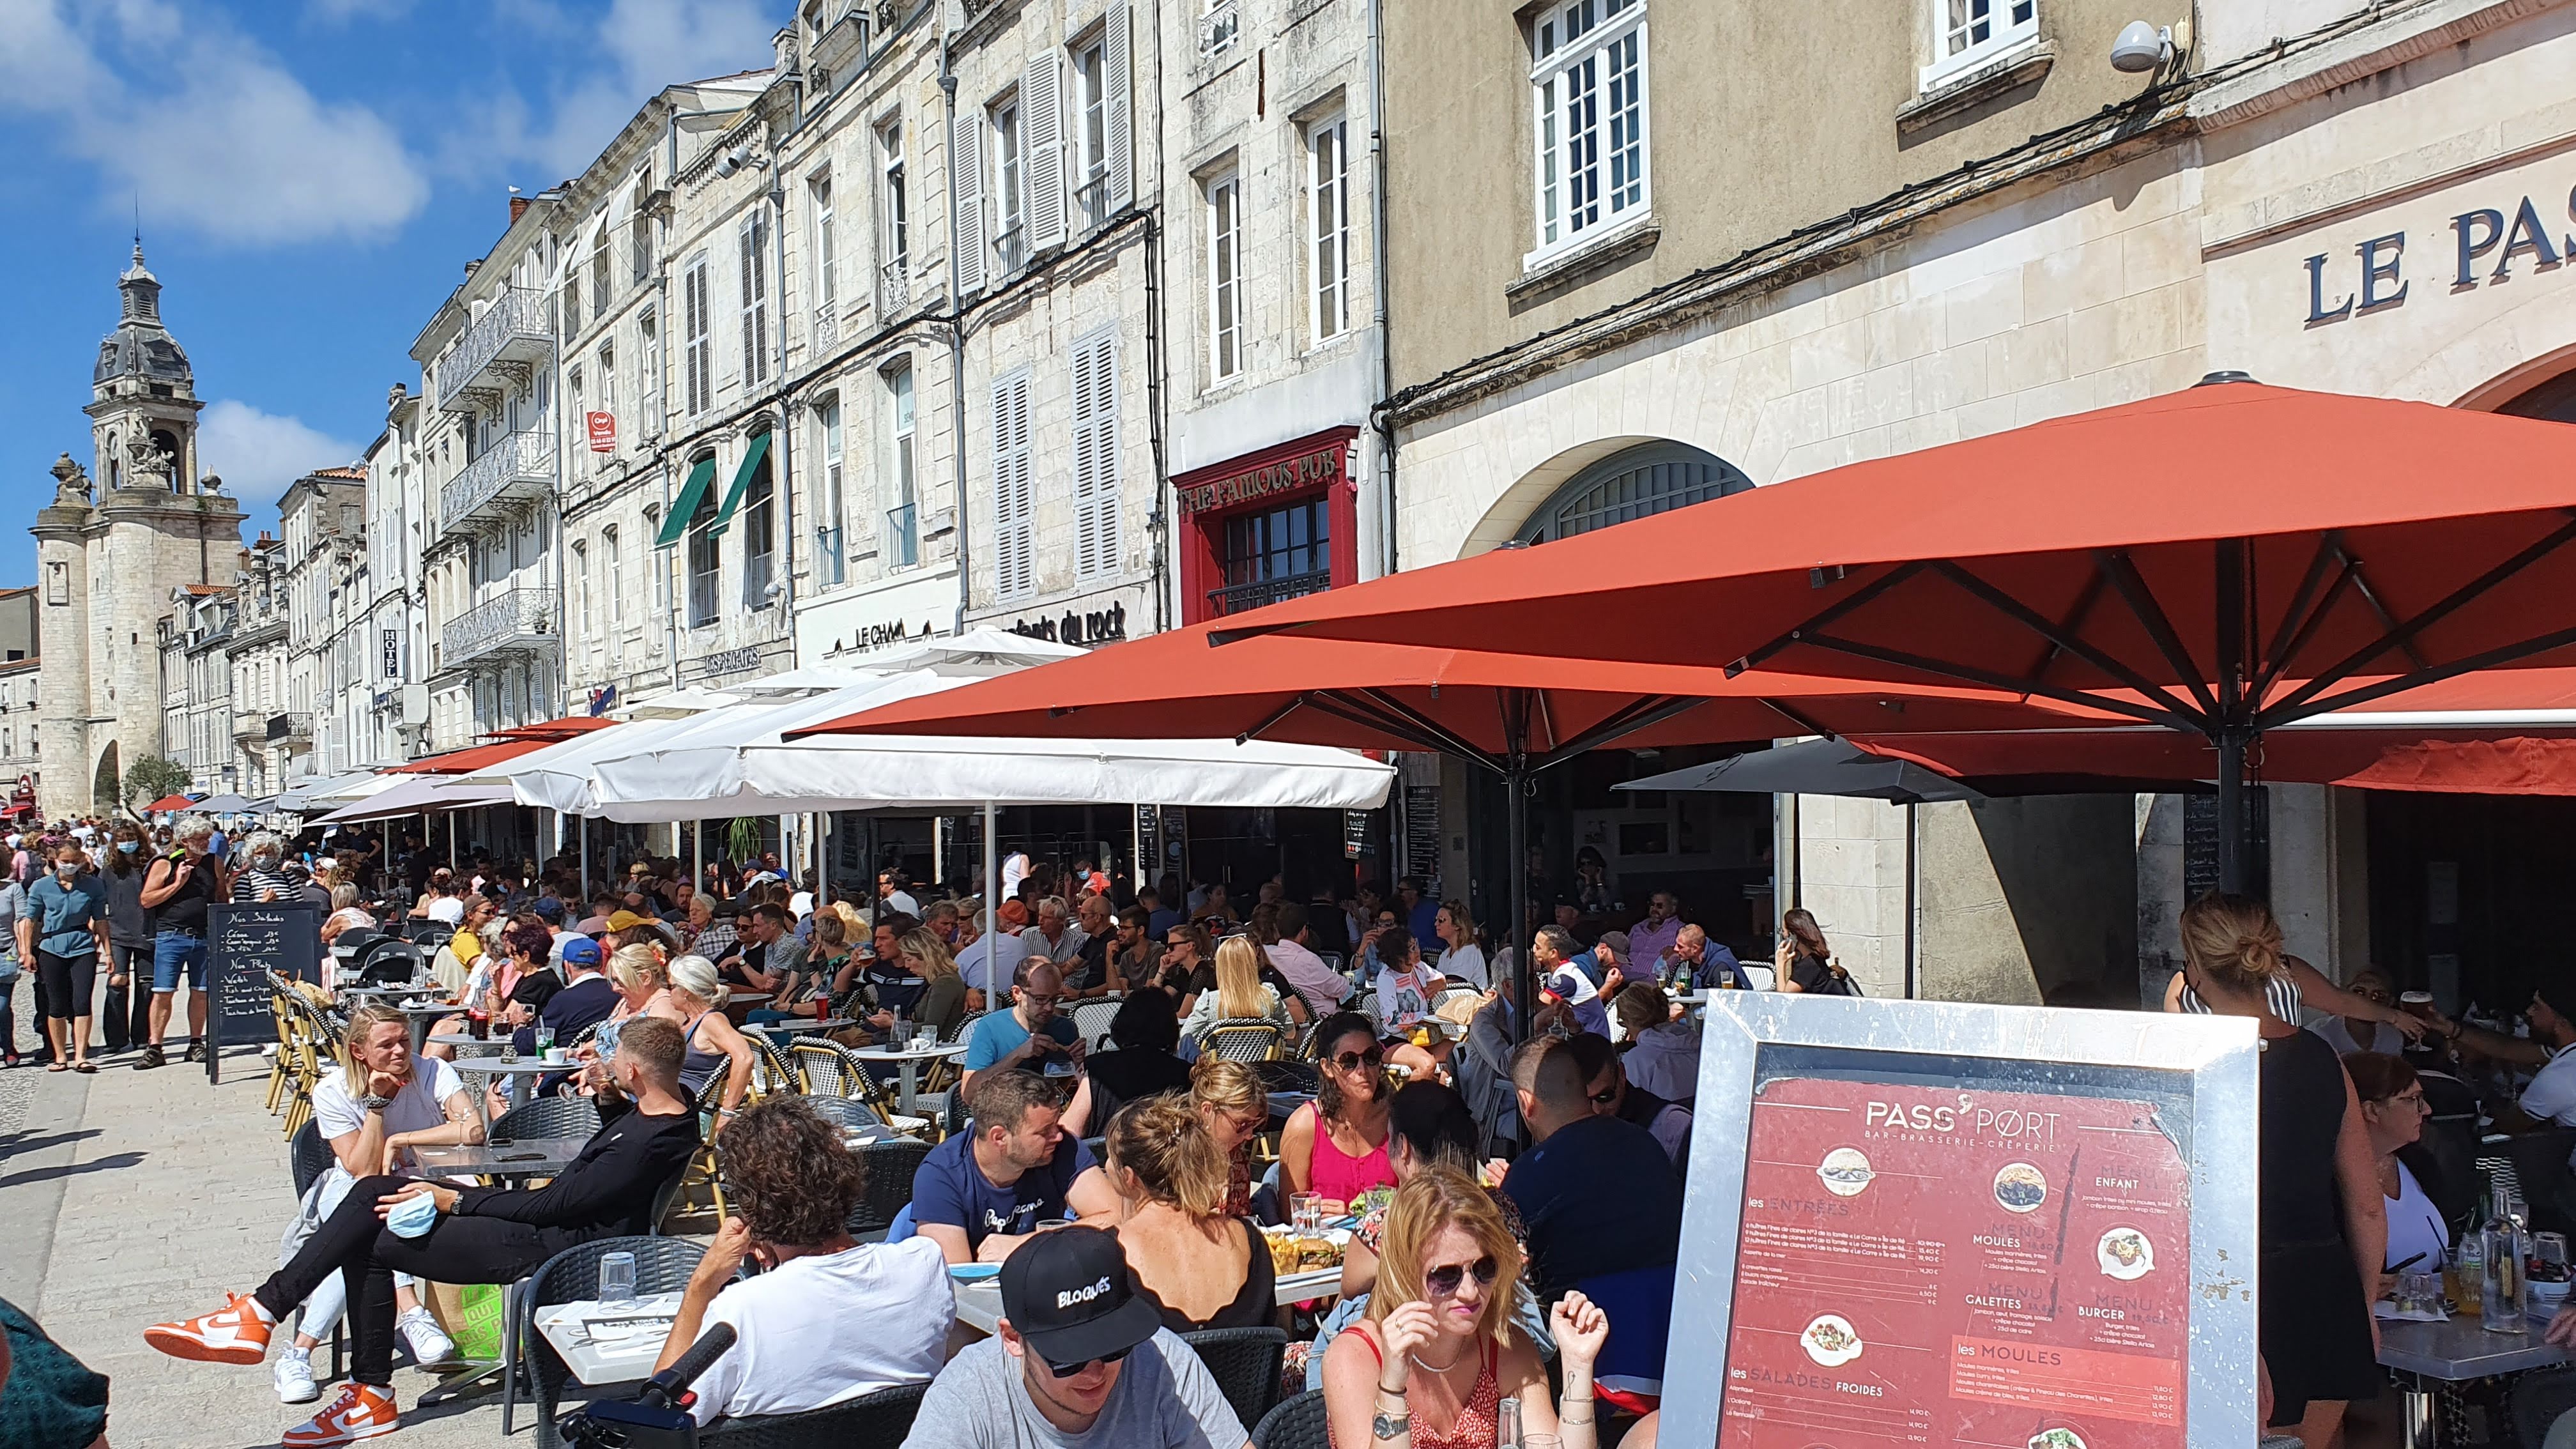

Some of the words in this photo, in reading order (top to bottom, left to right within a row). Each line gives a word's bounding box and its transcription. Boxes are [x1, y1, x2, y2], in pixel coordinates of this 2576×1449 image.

[2303, 231, 2409, 322] LE
[2451, 182, 2576, 286] PA
[1177, 485, 1213, 514] THE
[1216, 460, 1293, 505] FAMOUS
[1298, 449, 1336, 483] PUB
[1061, 610, 1083, 643] du
[1086, 601, 1126, 640] rock
[856, 627, 868, 648] LE
[384, 631, 397, 677] HOTEL
[228, 912, 246, 924] Nos
[230, 958, 246, 970] Nos
[2095, 1176, 2139, 1190] ENFANT
[1747, 1196, 1764, 1208] les
[1973, 1234, 2020, 1248] MOULES
[1057, 1276, 1111, 1308] BLOQUÉS
[1988, 1283, 2042, 1300] MENU
[1965, 1294, 2021, 1309] GALETTES
[2096, 1293, 2152, 1312] MENU
[468, 1303, 494, 1321] QUI
[2078, 1305, 2125, 1320] BURGER
[1958, 1343, 1975, 1356] les
[1981, 1344, 2061, 1366] MOULES
[1730, 1366, 1747, 1379] les
[1749, 1368, 1832, 1390] SALADES
[1836, 1381, 1883, 1397] FROIDES
